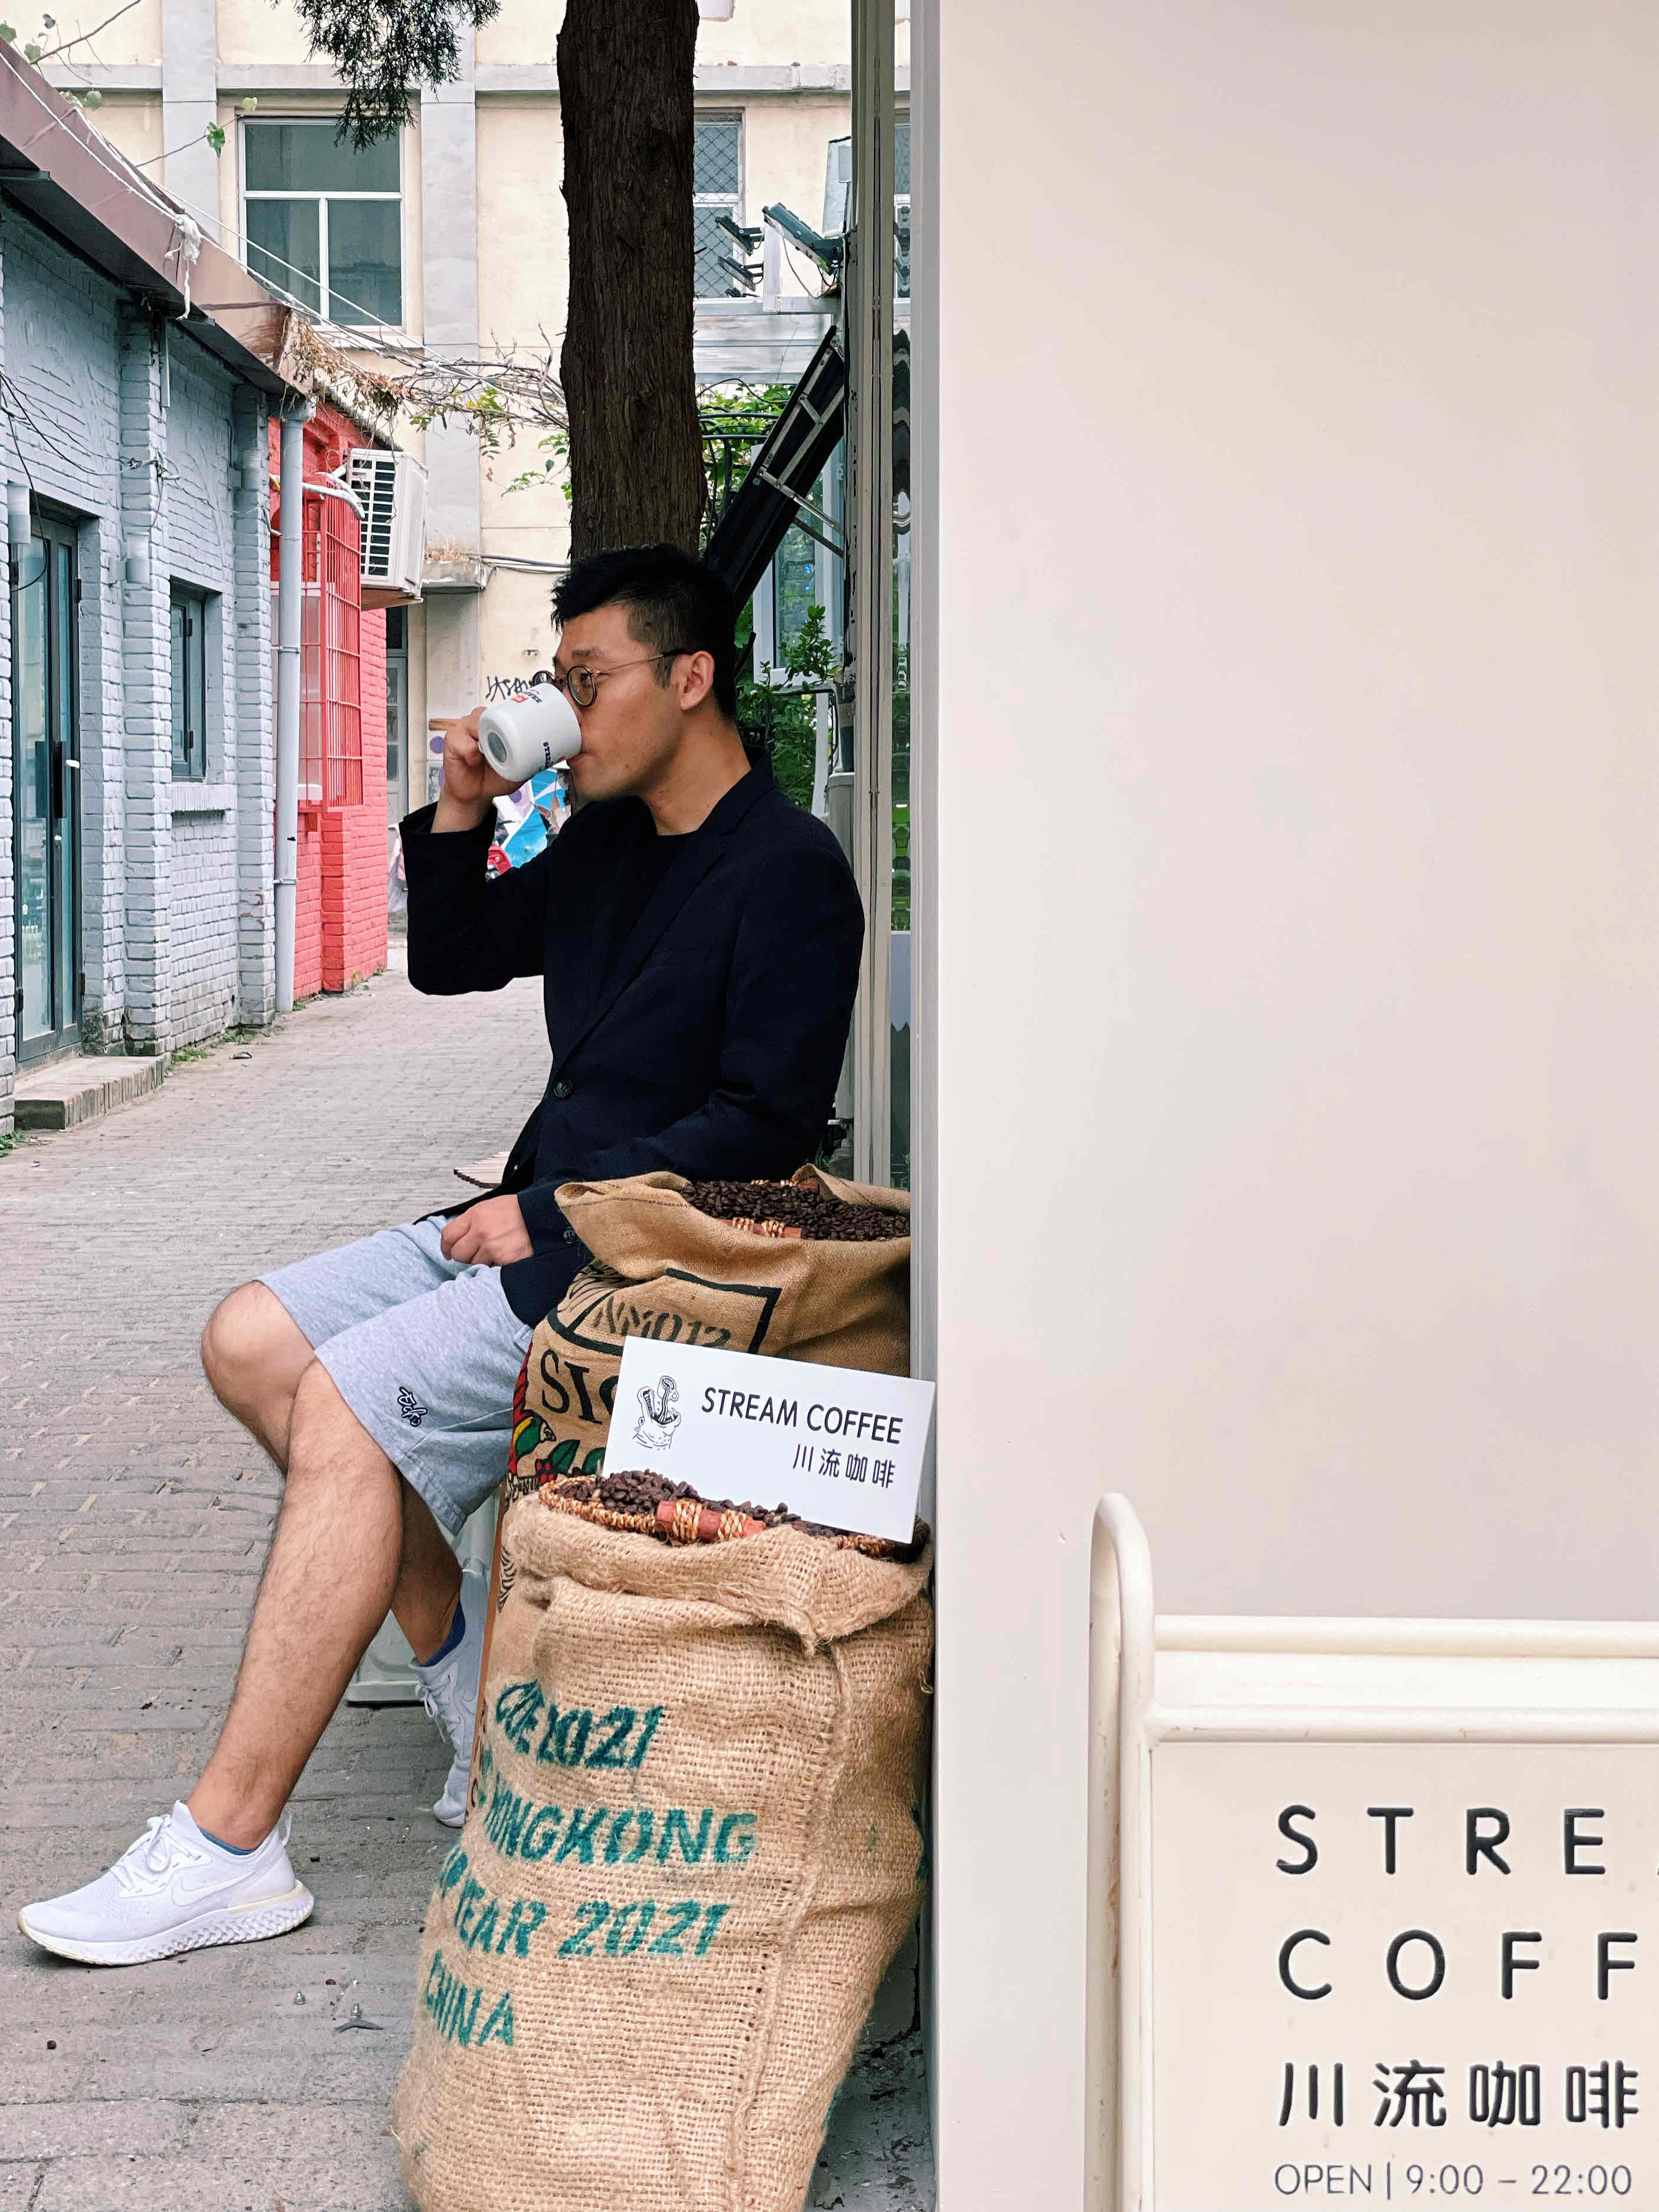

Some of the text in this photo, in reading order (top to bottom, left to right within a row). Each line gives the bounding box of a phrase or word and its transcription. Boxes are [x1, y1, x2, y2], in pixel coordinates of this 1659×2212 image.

[701, 1386, 904, 1445] STREAM COFFEE
[792, 1443, 896, 1489] 川流咖啡
[1275, 1805, 1659, 1875] STRE
[557, 1898, 731, 1958] 2021
[1278, 1929, 1638, 2000] COFF
[1278, 2059, 1640, 2129] 川流咖啡
[1274, 2163, 1372, 2195] OPEN
[1405, 2163, 1484, 2195] 9:00
[1530, 2163, 1632, 2195] 22:00
